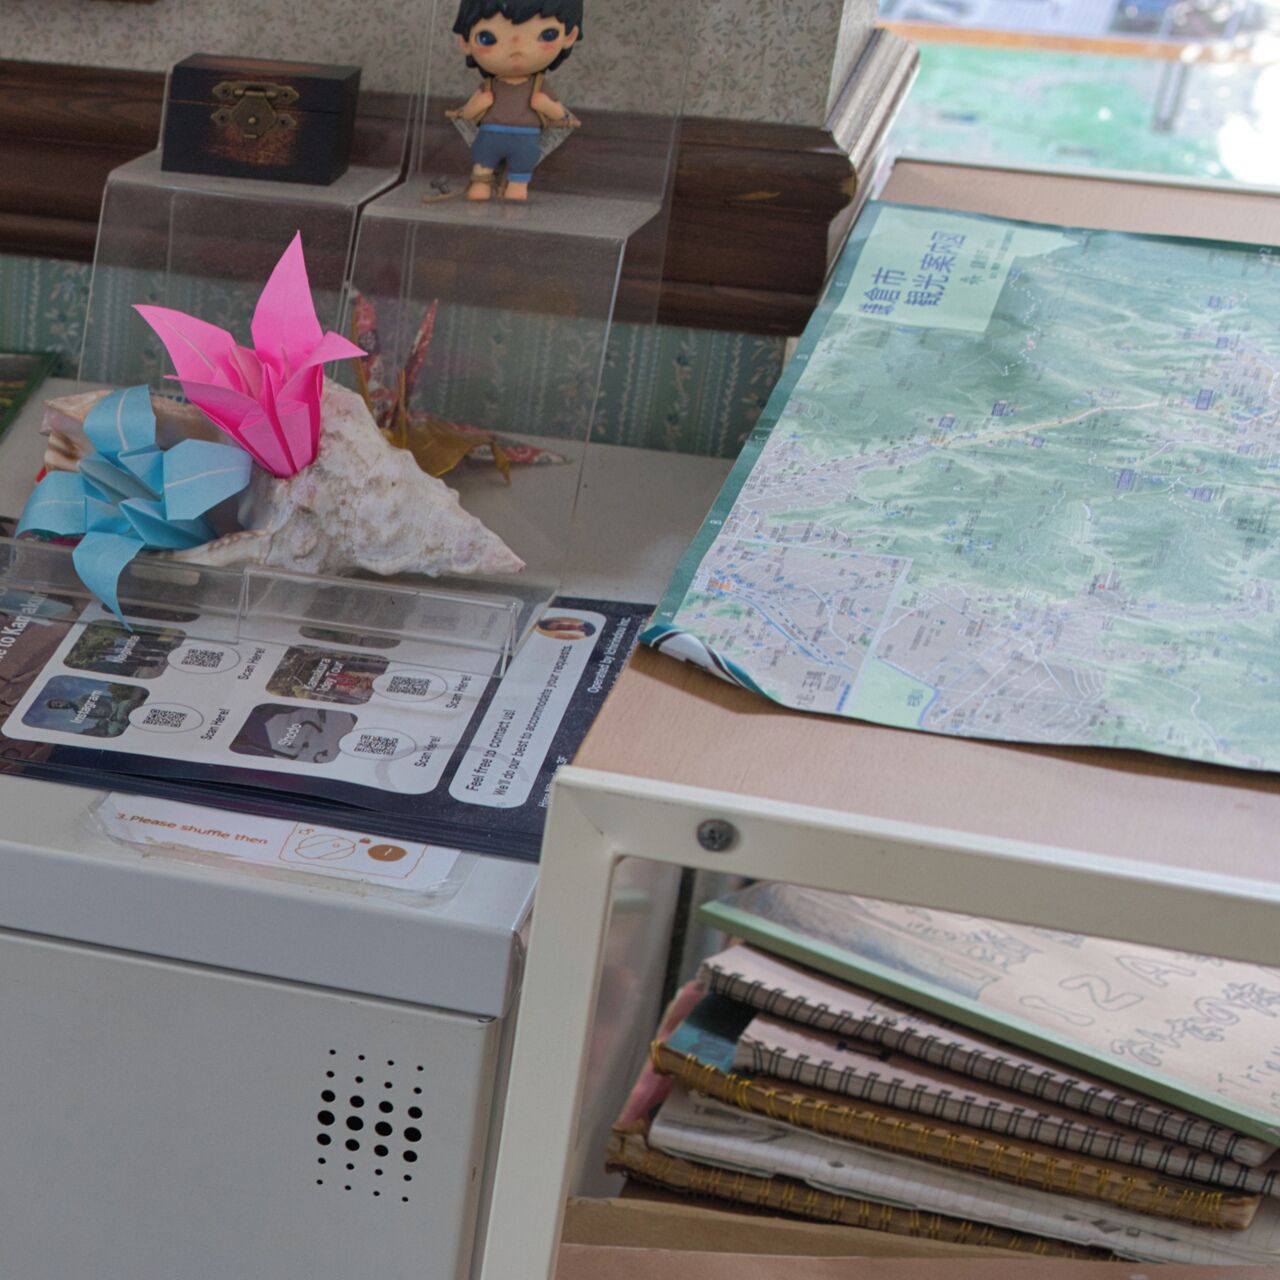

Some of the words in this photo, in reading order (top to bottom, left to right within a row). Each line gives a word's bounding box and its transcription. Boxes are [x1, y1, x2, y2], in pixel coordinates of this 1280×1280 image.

[587, 664, 608, 694] Operated
[445, 691, 462, 710] Scan
[526, 687, 554, 734] accommodate
[200, 724, 217, 741] Scan
[465, 770, 485, 792] Feel
[476, 755, 493, 775] free
[489, 717, 511, 748] contact
[180, 825, 229, 841] shuffle
[234, 833, 269, 846] then
